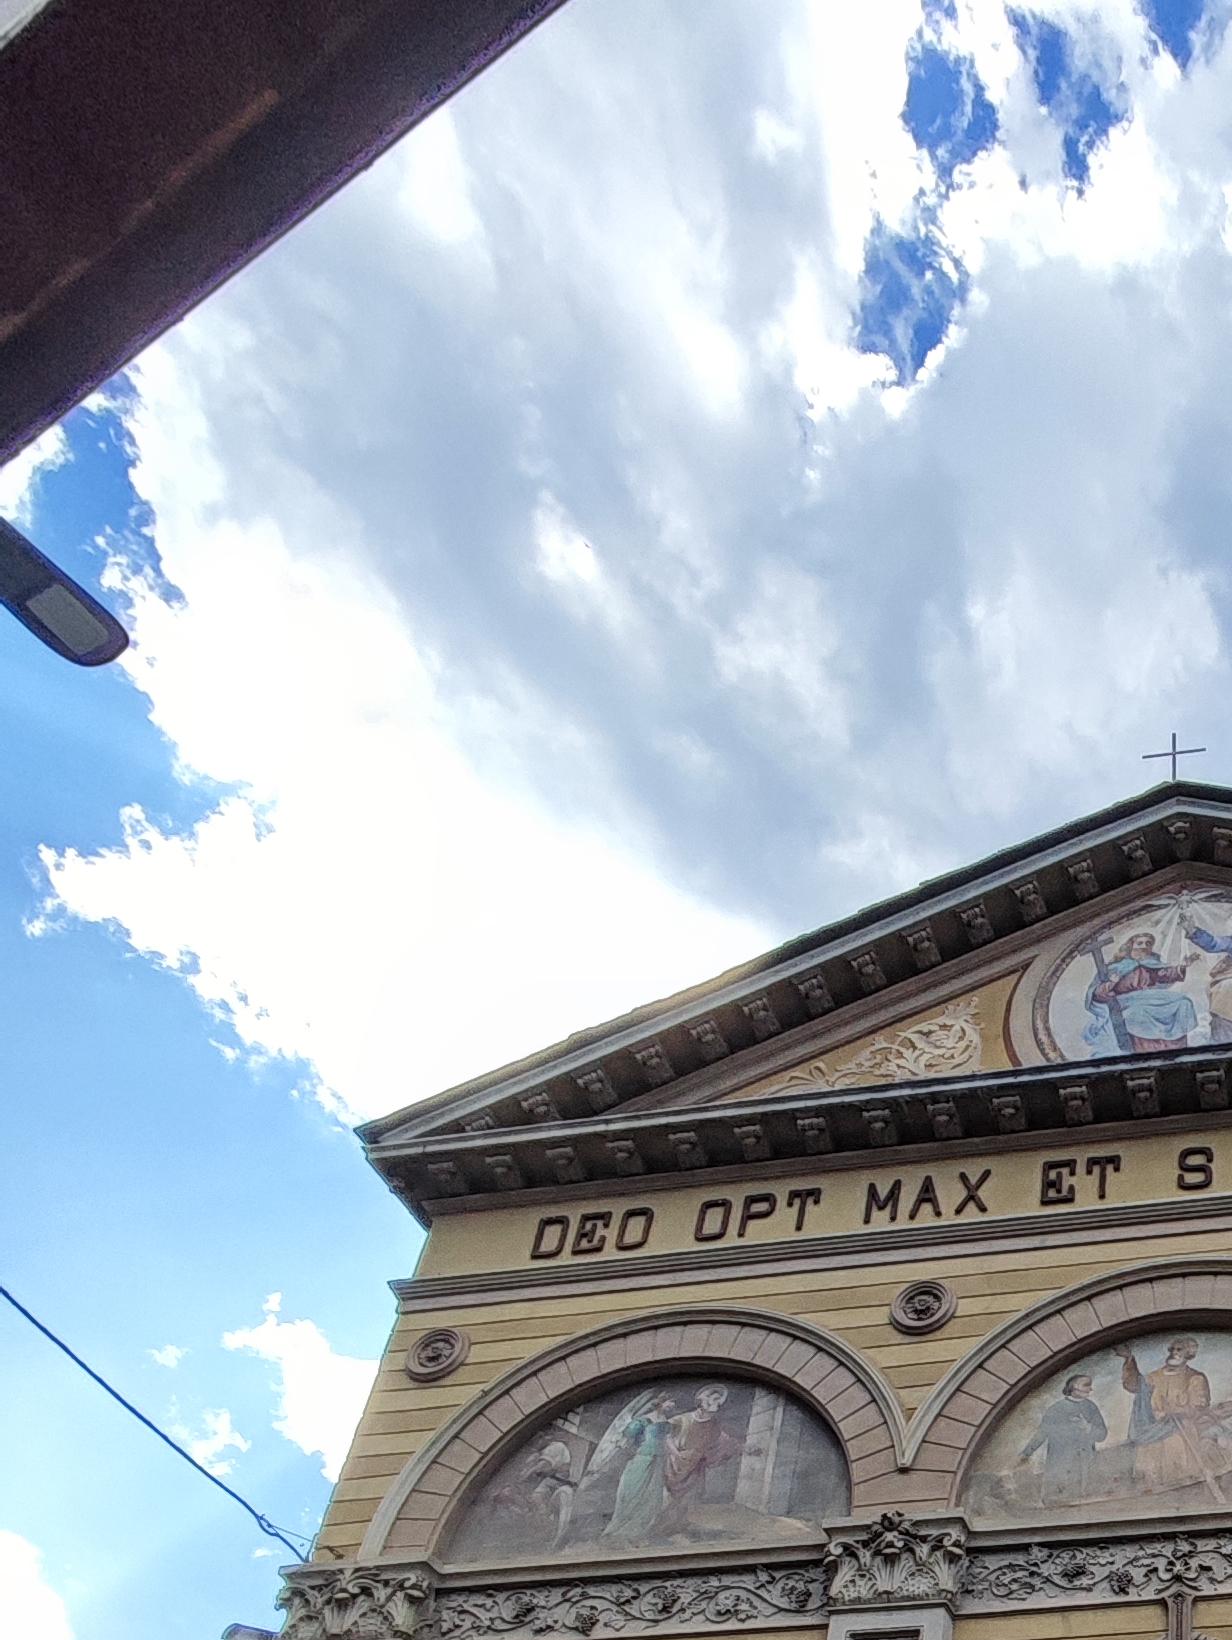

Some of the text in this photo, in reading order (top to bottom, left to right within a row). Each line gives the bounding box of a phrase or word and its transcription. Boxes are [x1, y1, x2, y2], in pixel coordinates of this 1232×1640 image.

[530, 1206, 655, 1260] DEO
[694, 1187, 822, 1241] OPT
[863, 1169, 992, 1225] MAX
[1040, 1154, 1121, 1206] ET
[1177, 1146, 1213, 1190] S
